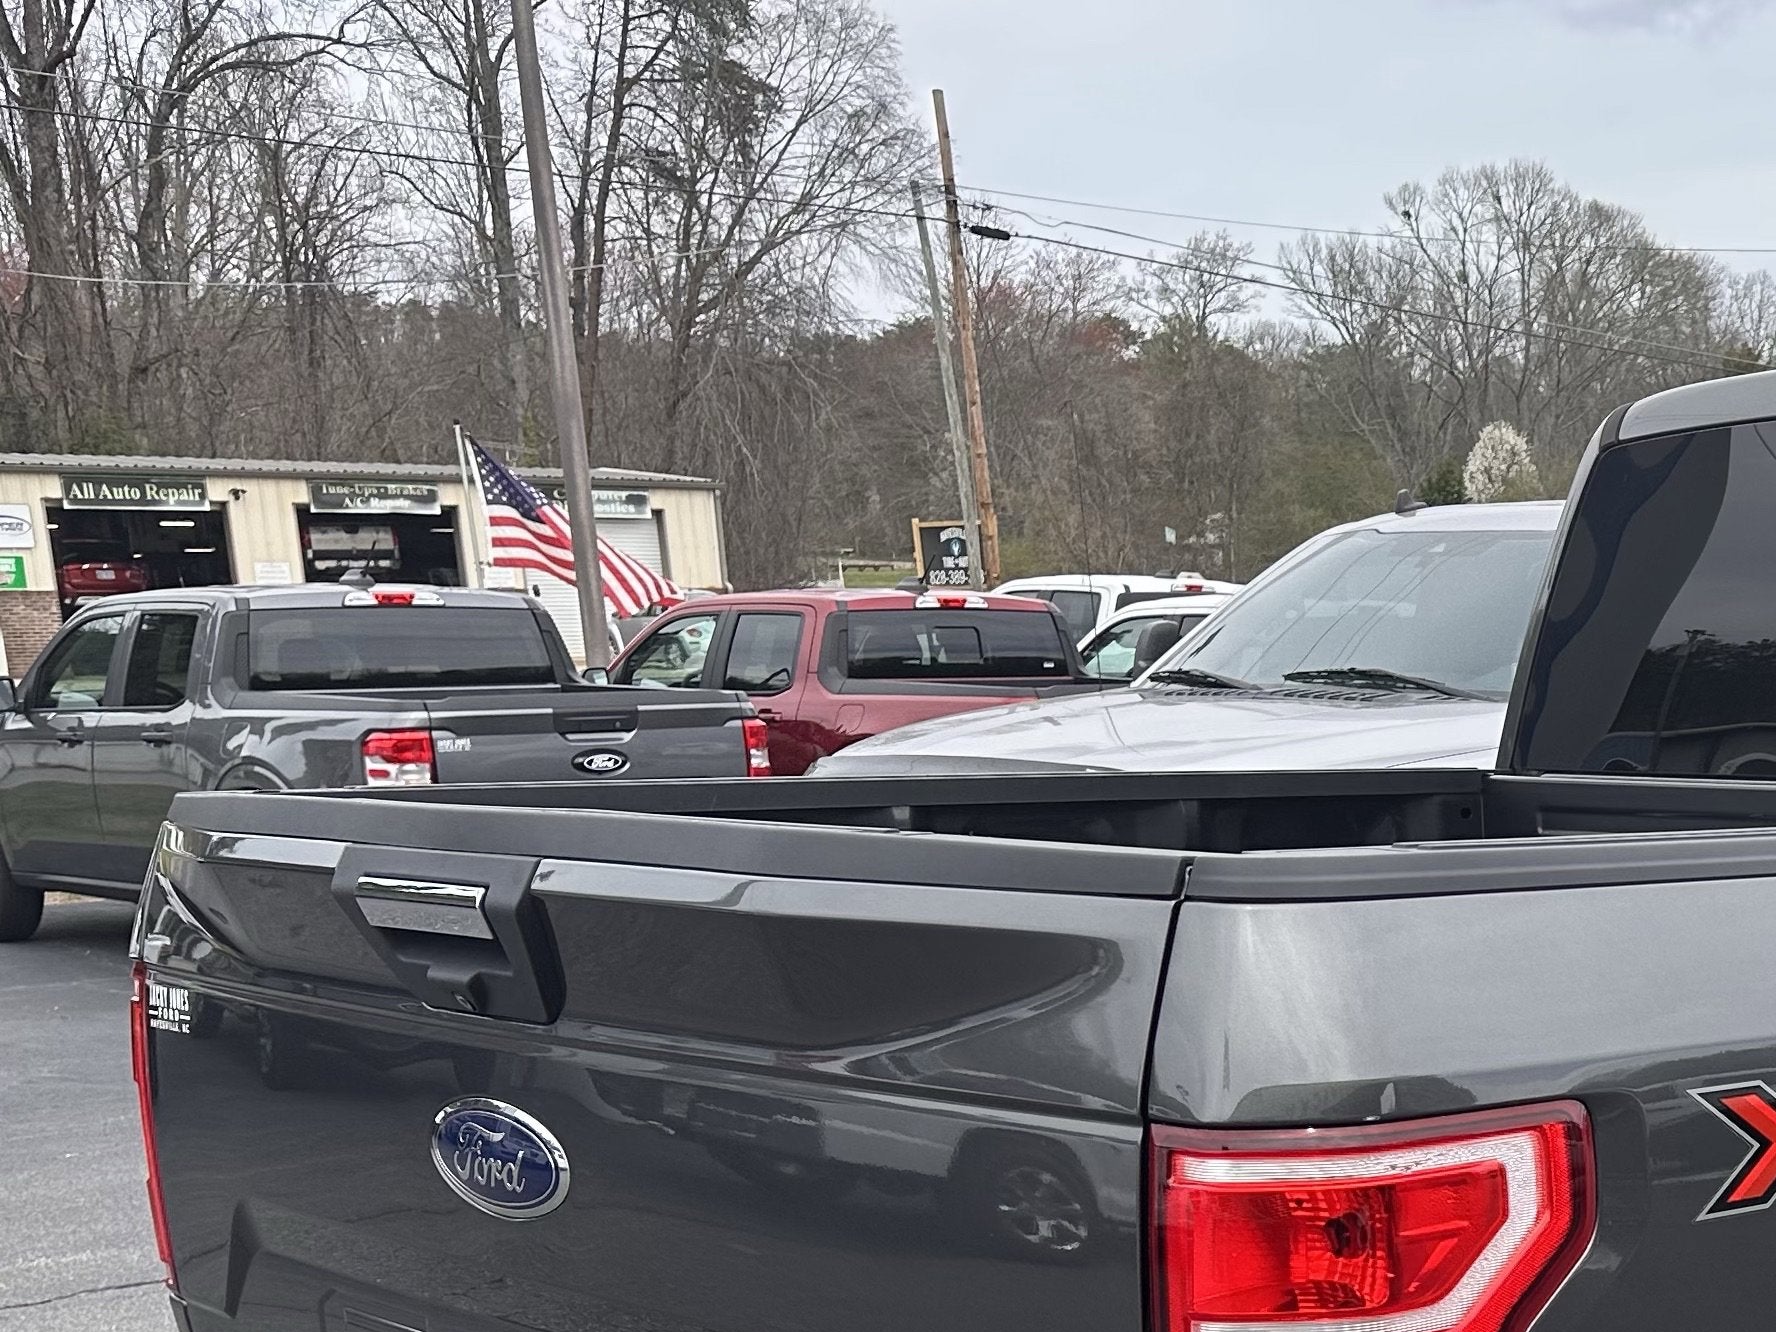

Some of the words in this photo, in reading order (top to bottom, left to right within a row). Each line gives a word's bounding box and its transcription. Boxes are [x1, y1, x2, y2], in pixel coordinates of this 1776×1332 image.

[68, 481, 95, 500] All
[98, 482, 141, 500] Auto
[145, 482, 203, 505] Repair
[453, 1121, 526, 1194] Ford
